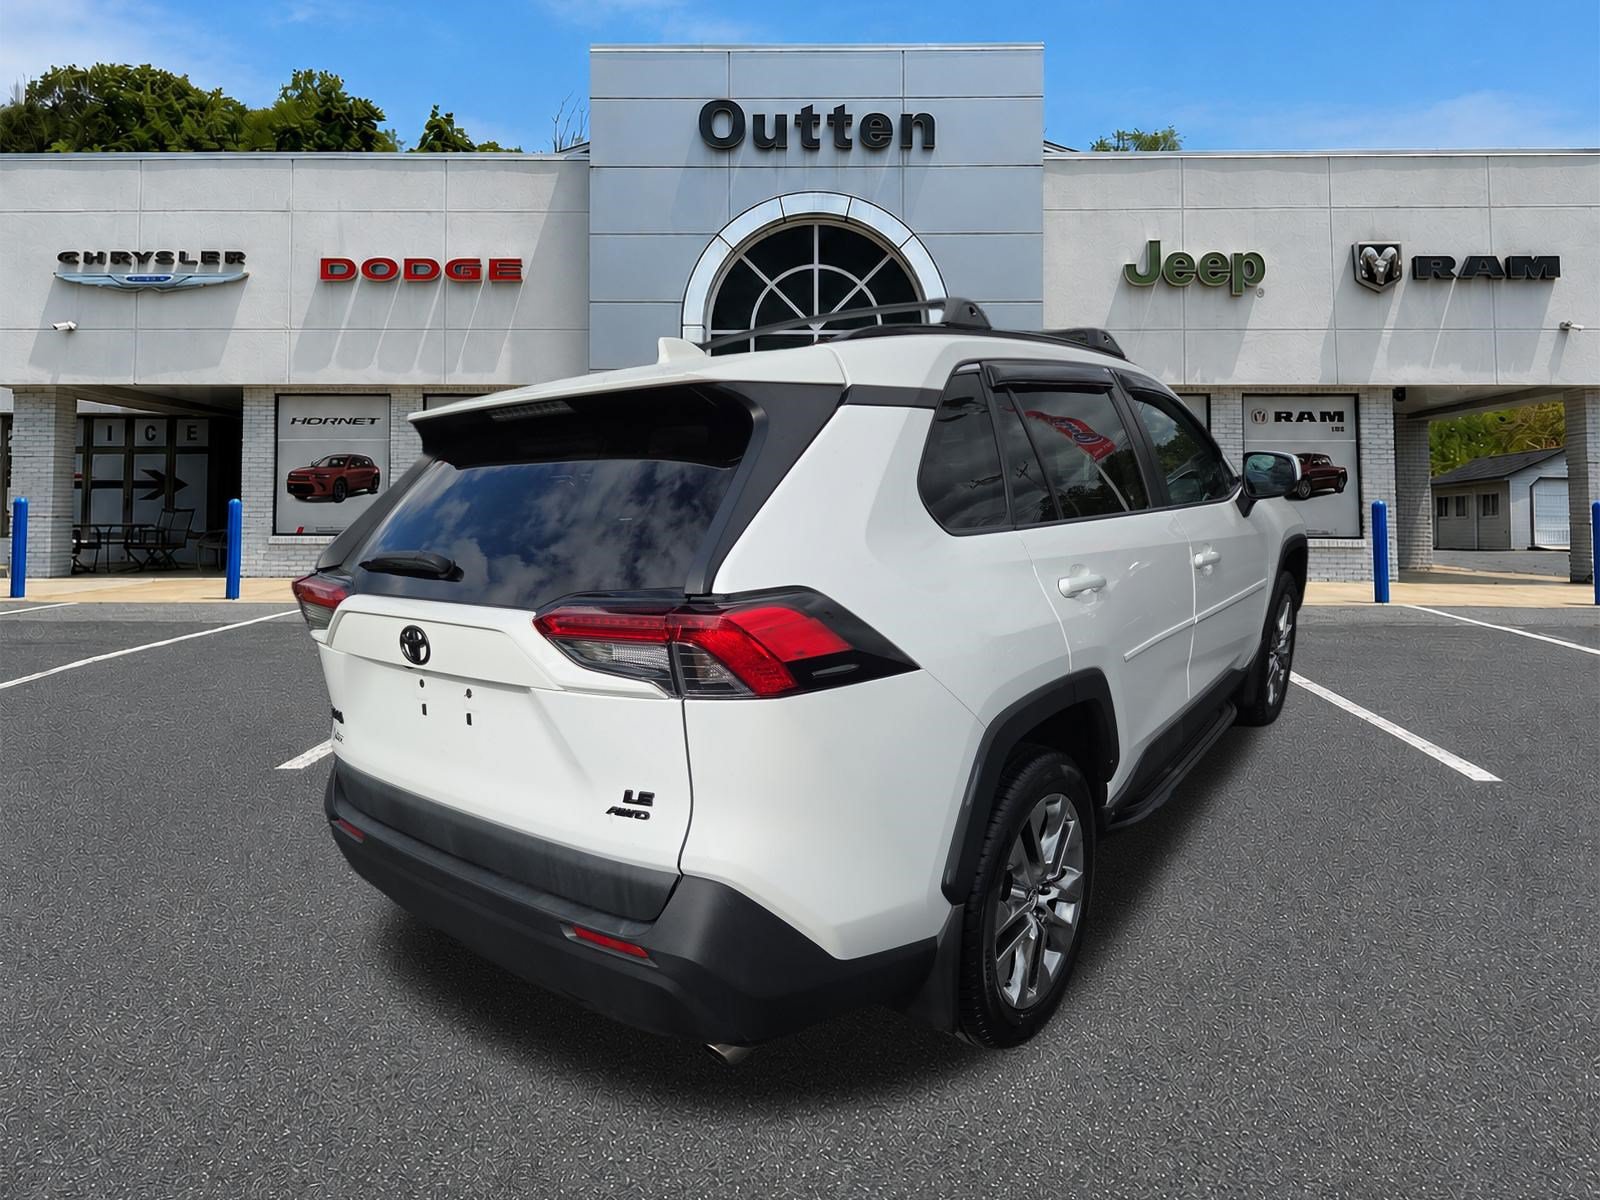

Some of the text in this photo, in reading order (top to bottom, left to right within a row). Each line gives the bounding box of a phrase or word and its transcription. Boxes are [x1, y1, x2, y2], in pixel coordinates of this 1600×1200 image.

[699, 99, 936, 151] Outten
[57, 250, 247, 267] CHRYSLER
[320, 257, 523, 282] DODGE
[1123, 240, 1266, 296] Jeep
[1411, 255, 1561, 281] RAM
[291, 416, 381, 426] HORNET
[1274, 411, 1345, 423] RAM
[622, 789, 656, 807] LE
[605, 805, 651, 821] AWD
